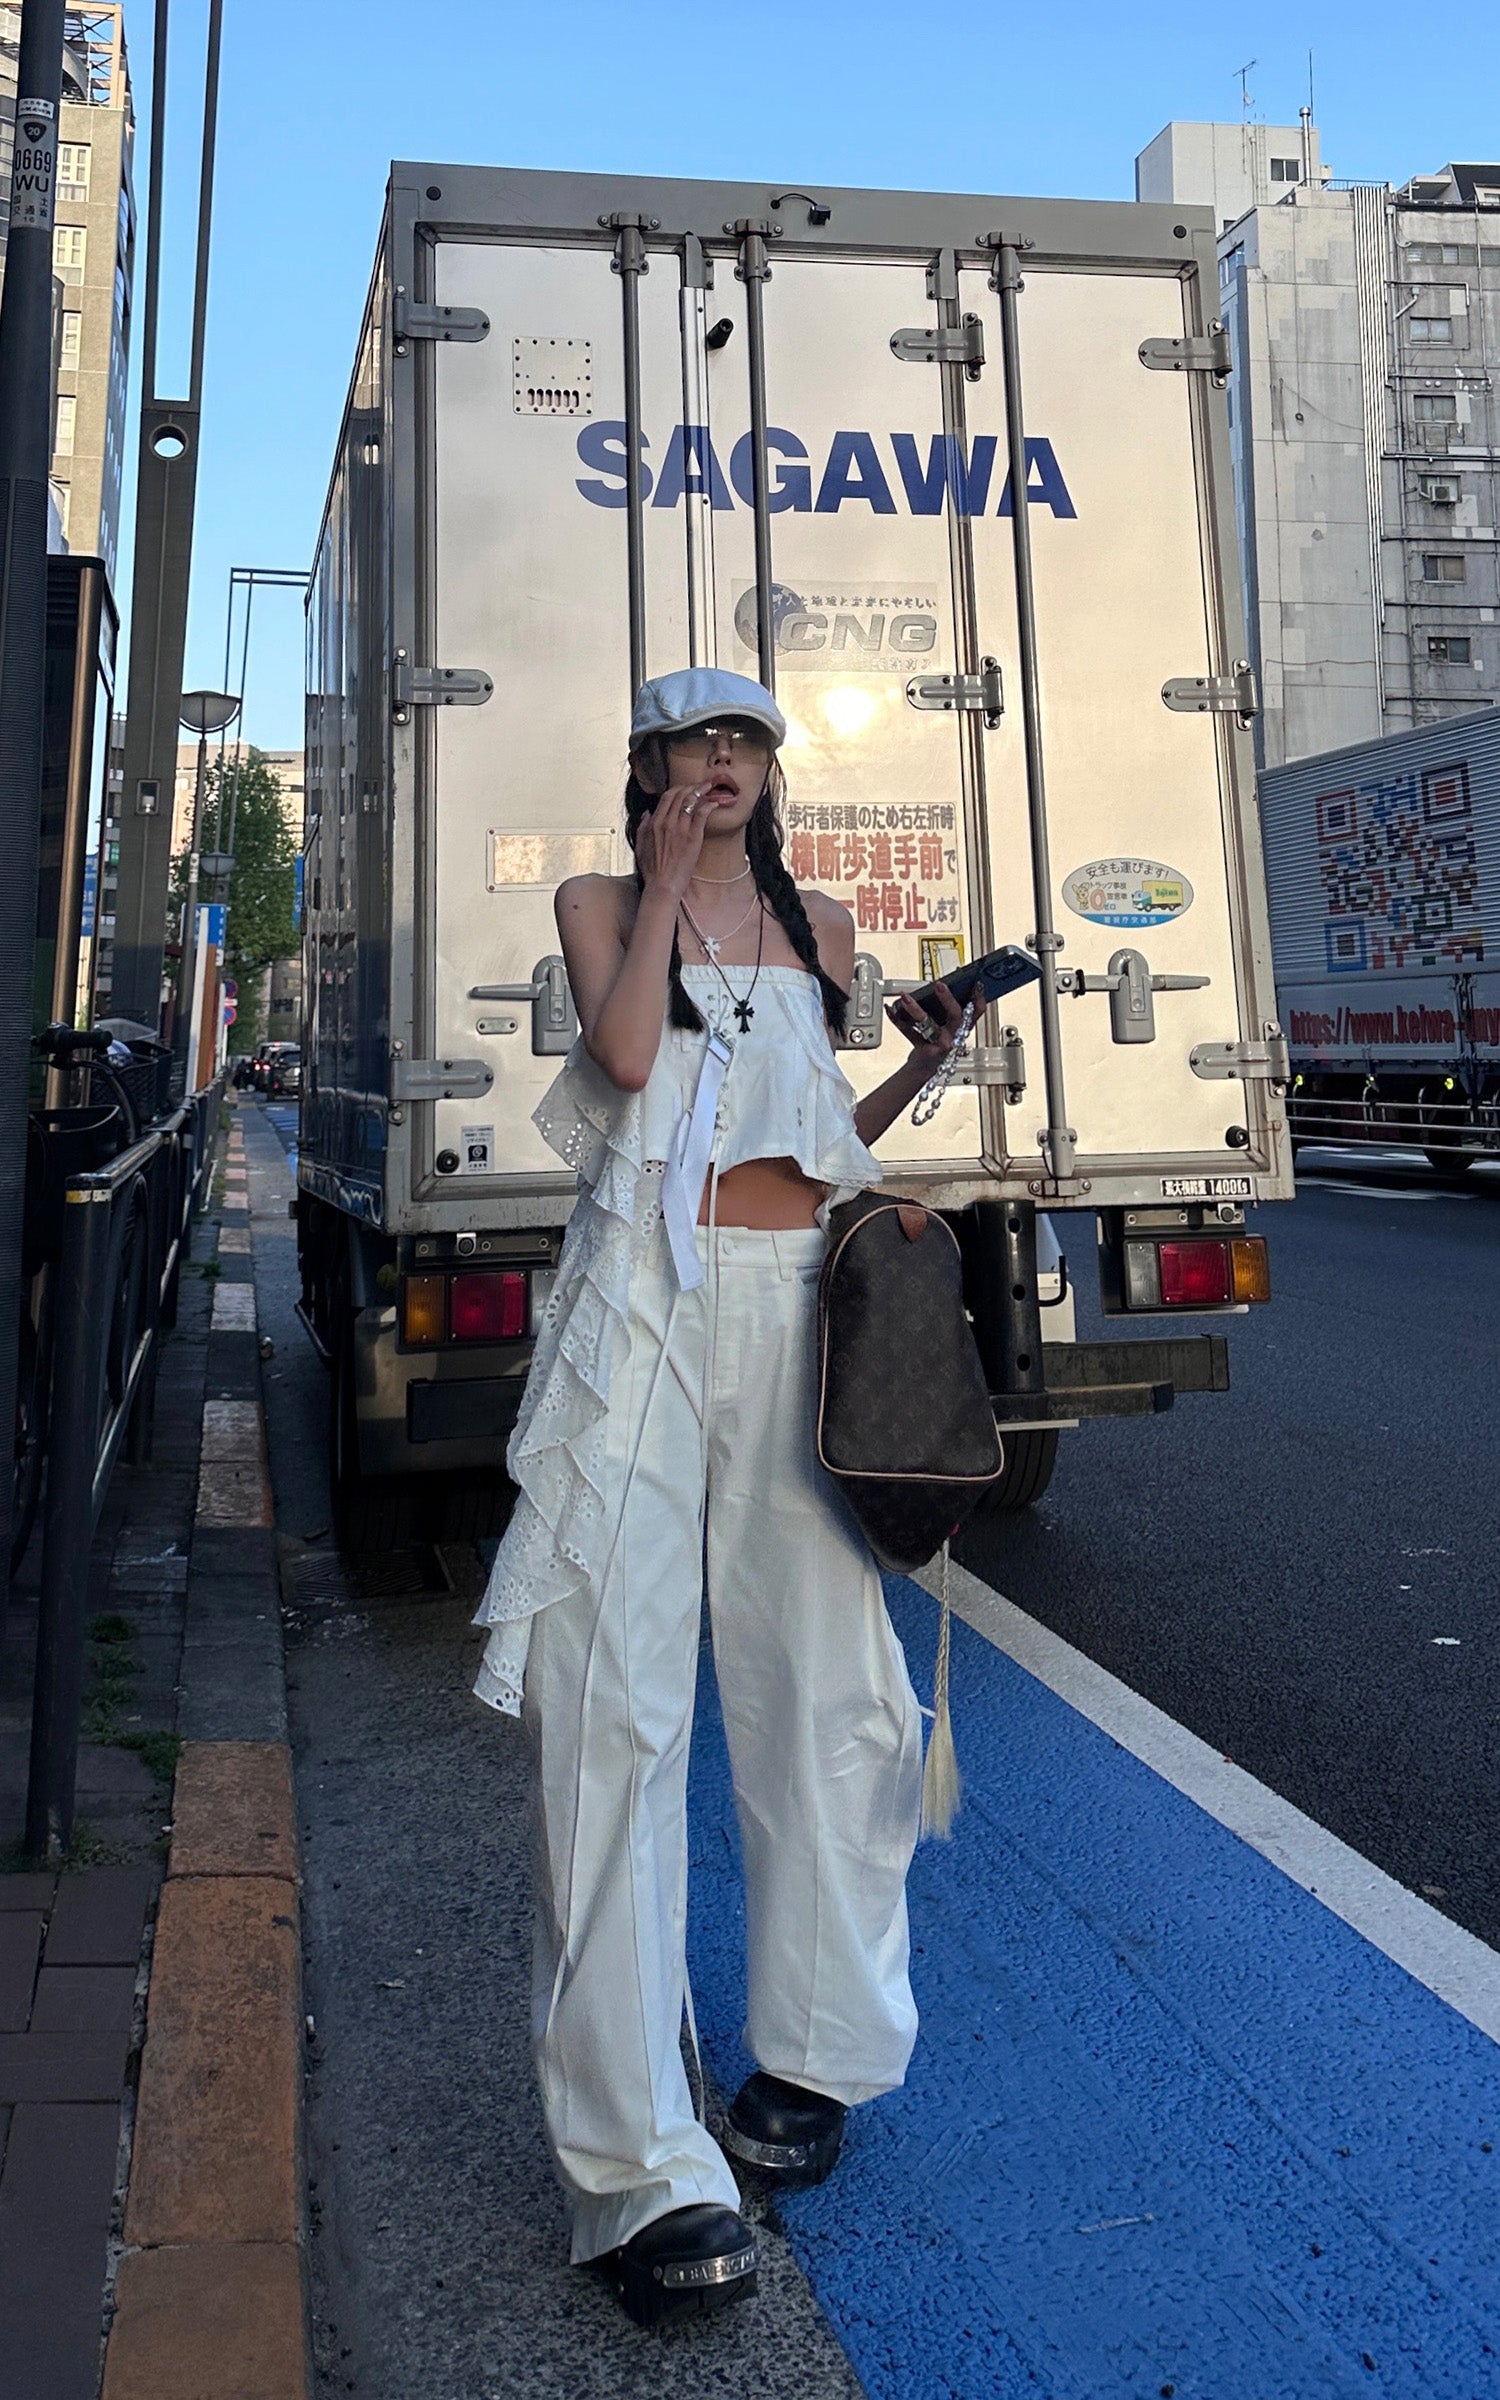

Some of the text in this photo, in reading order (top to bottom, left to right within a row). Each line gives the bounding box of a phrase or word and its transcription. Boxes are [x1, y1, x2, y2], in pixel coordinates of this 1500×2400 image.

[28, 127, 40, 136] 20
[15, 148, 52, 173] 0669
[15, 174, 49, 192] WU
[575, 420, 1077, 519] SAGAWA
[779, 613, 937, 652] CNG
[788, 804, 954, 831] 歩行者保護のため右左折時
[790, 831, 957, 881] 横断歩道手前で
